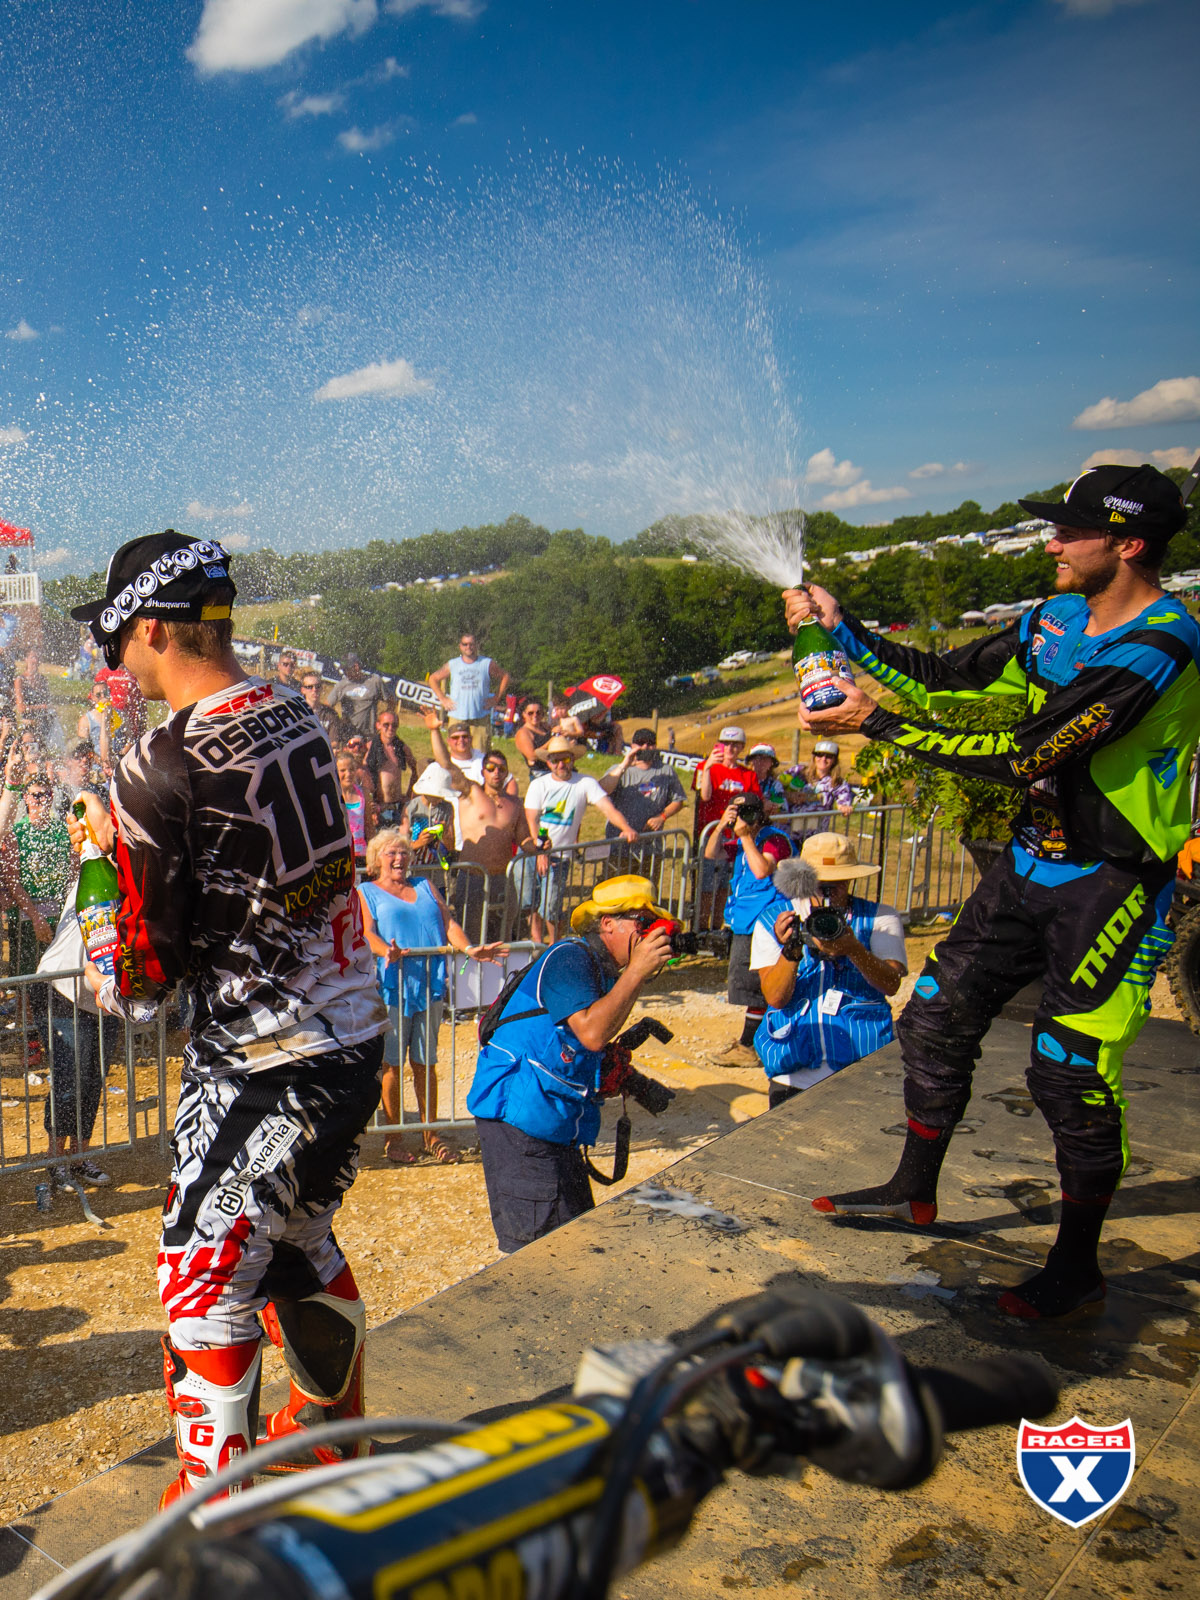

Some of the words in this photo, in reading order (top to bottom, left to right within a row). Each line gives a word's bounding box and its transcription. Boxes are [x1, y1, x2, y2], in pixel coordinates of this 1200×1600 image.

[1104, 504, 1139, 516] RACING
[1113, 497, 1144, 512] YAMAHA
[152, 599, 191, 610] Husqvarna
[198, 696, 315, 769] OSBORNE
[893, 723, 1022, 757] THOR
[255, 735, 347, 873] 16
[1069, 882, 1149, 990] THOR
[231, 1124, 291, 1192] Husqvarna
[268, 1148, 284, 1169] FACTORY
[283, 1130, 298, 1148] RACING
[189, 1423, 215, 1447] G
